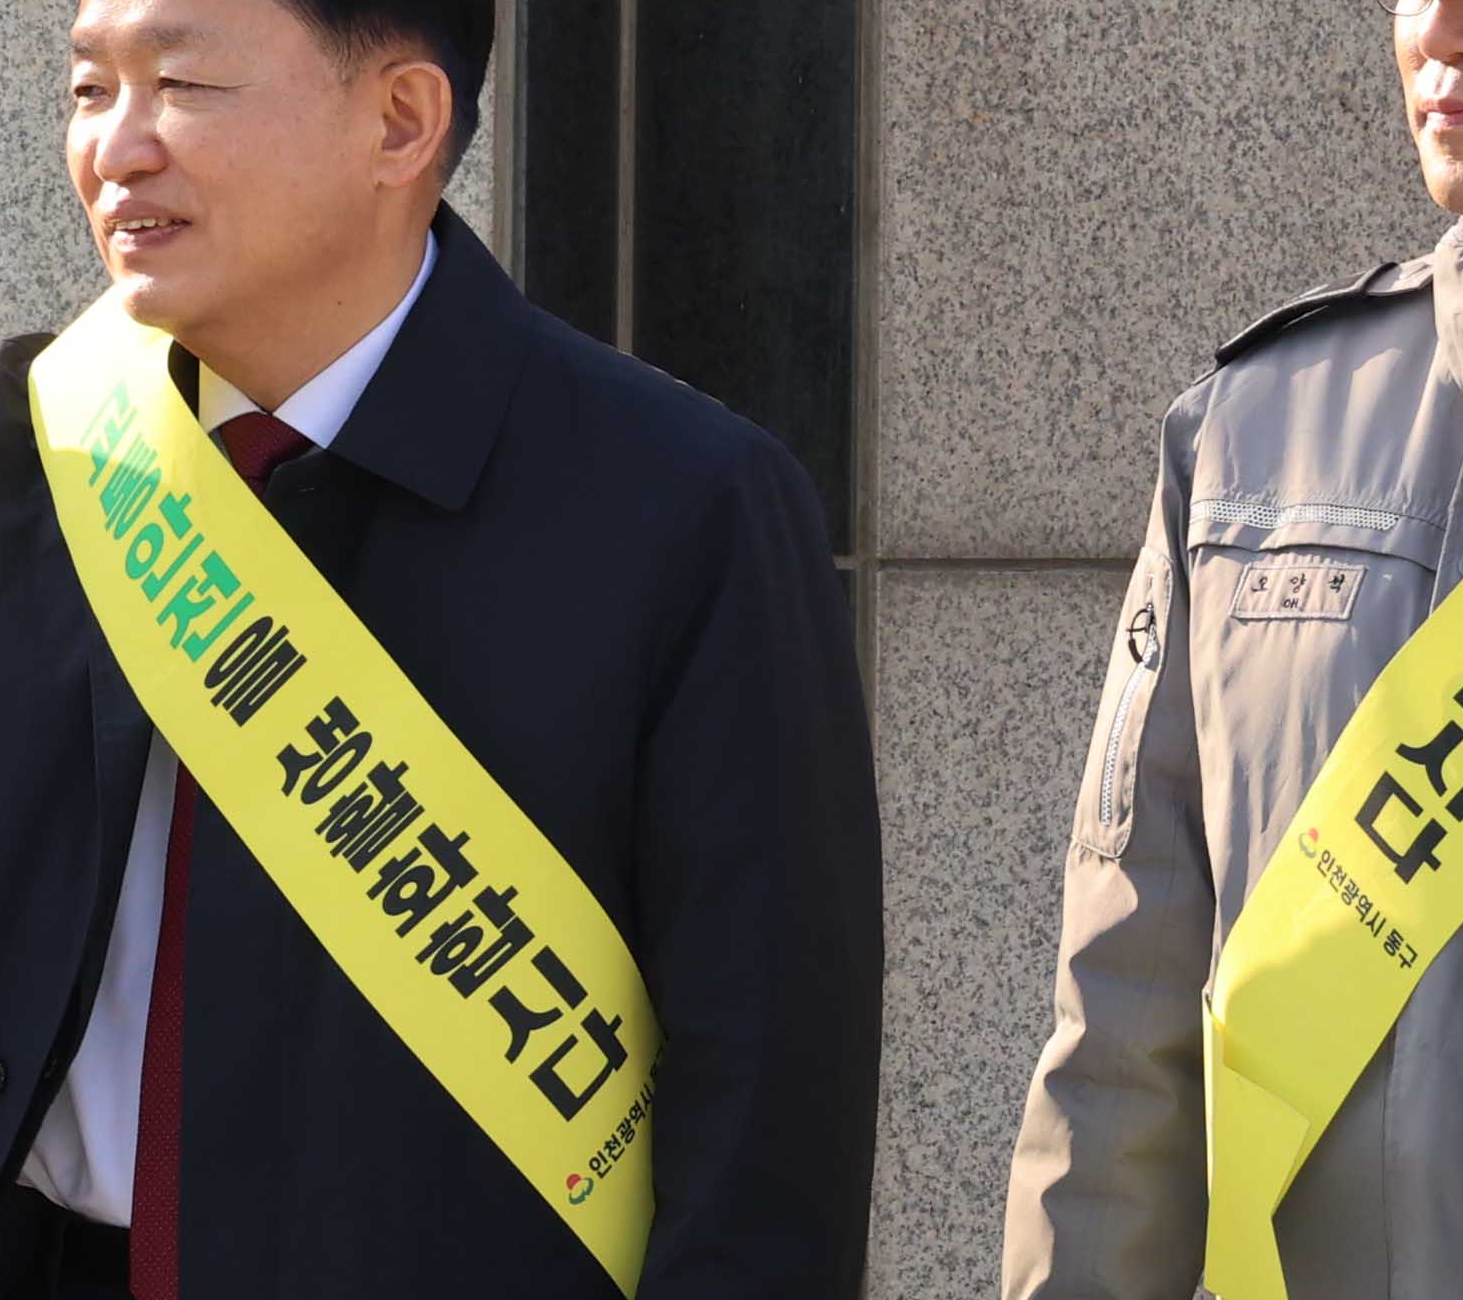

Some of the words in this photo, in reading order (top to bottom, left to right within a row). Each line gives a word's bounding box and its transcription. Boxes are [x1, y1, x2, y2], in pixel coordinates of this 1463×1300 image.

[80, 381, 307, 727] 교통안전을
[276, 695, 629, 1121] 생활화합시다
[1316, 849, 1385, 939] 인천광역시
[1382, 928, 1419, 971] 동구
